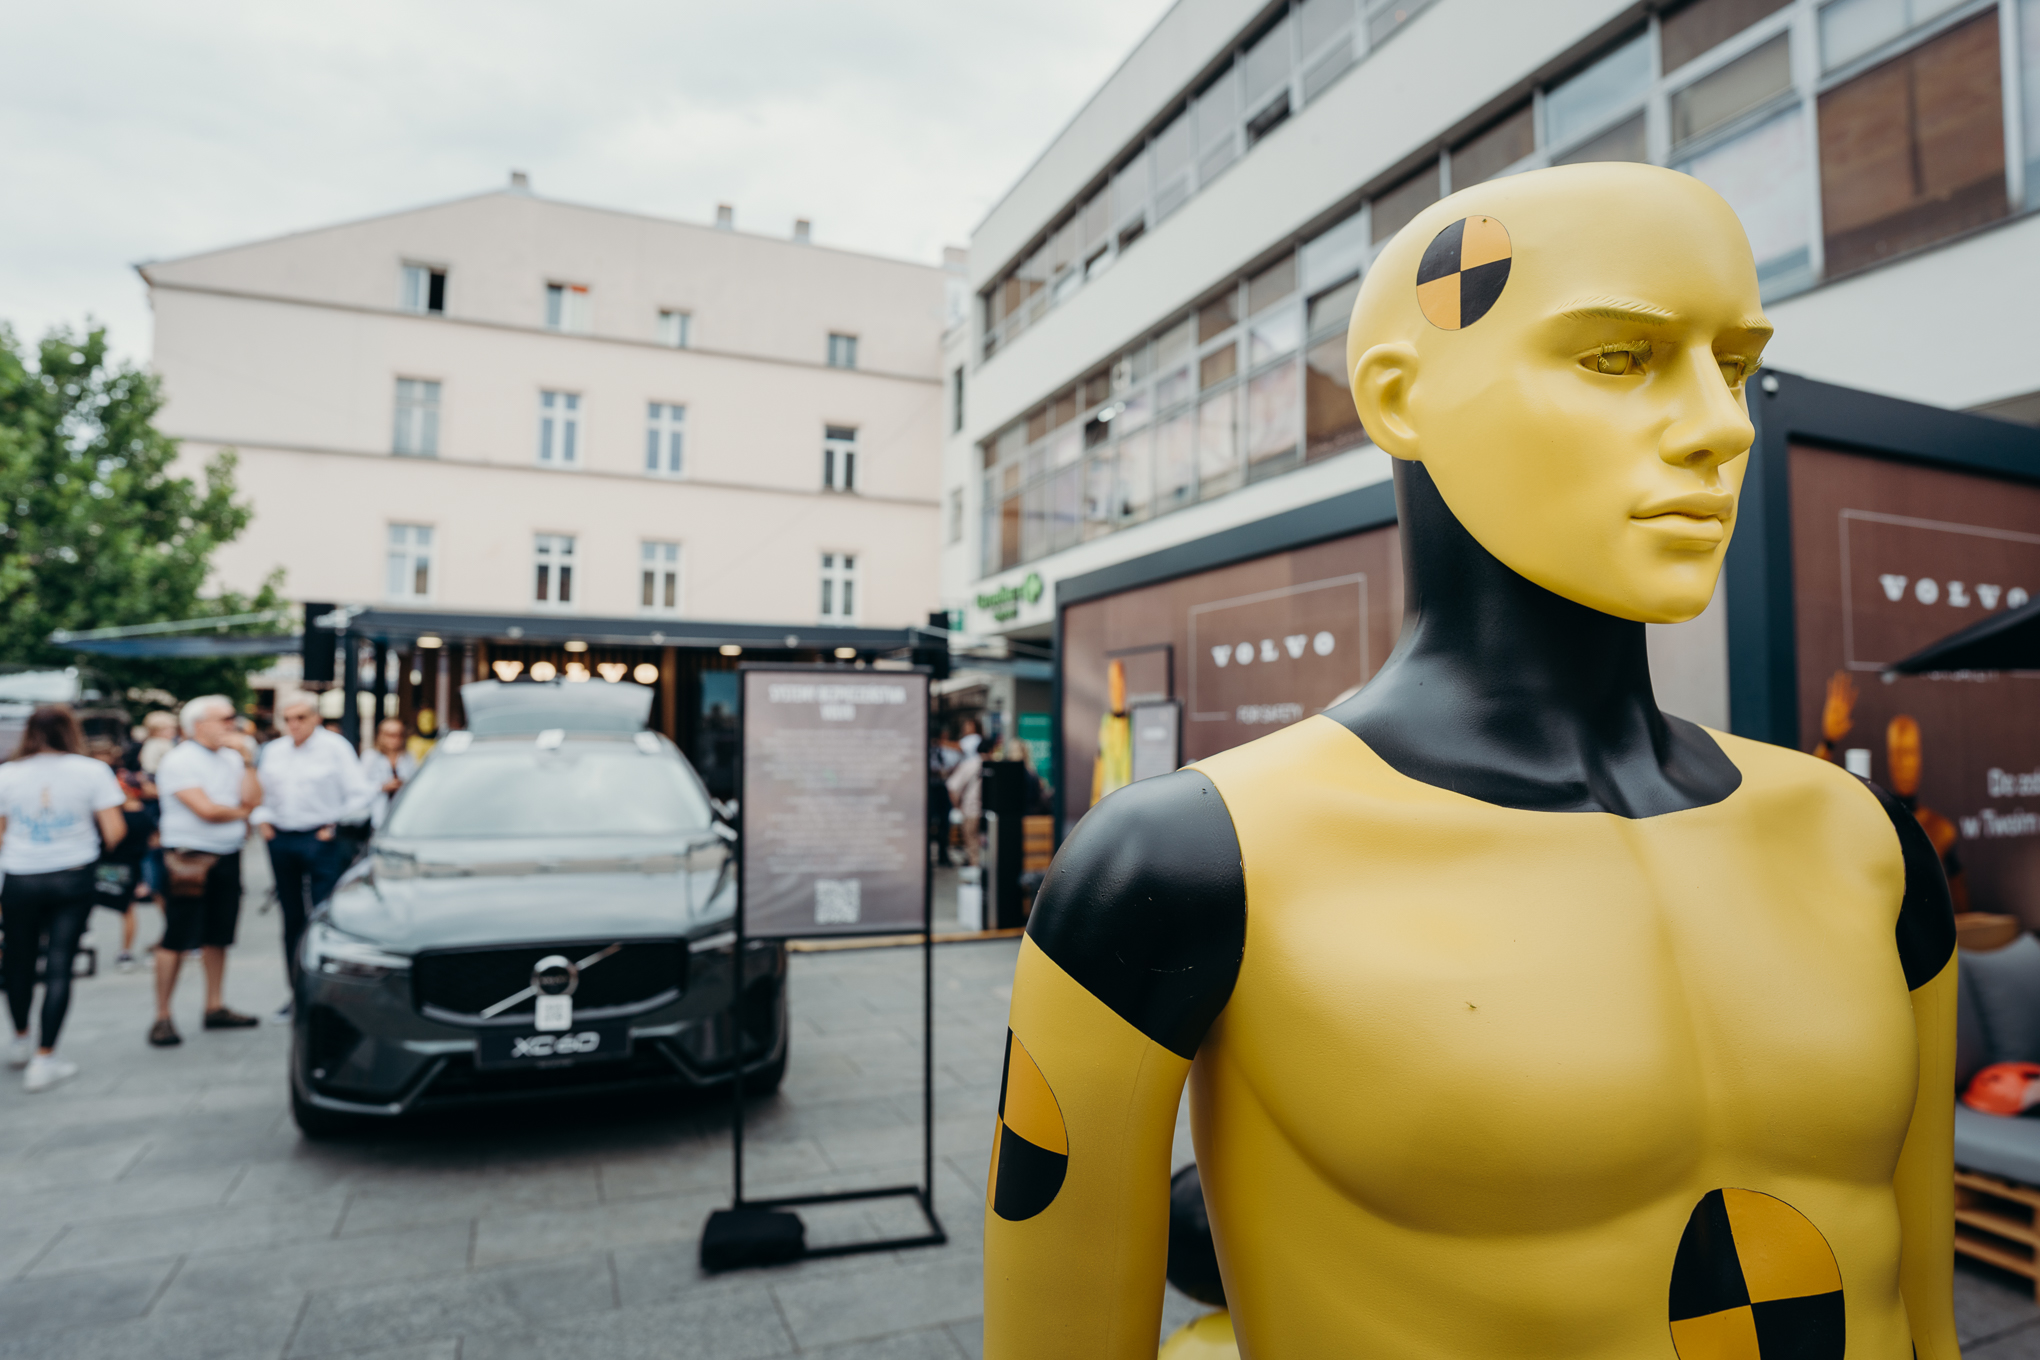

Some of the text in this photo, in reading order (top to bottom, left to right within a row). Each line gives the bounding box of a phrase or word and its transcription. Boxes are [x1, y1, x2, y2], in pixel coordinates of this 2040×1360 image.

[1211, 630, 1335, 668] VOLVO
[492, 660, 659, 684] VOLVO
[511, 1031, 600, 1057] XC60
